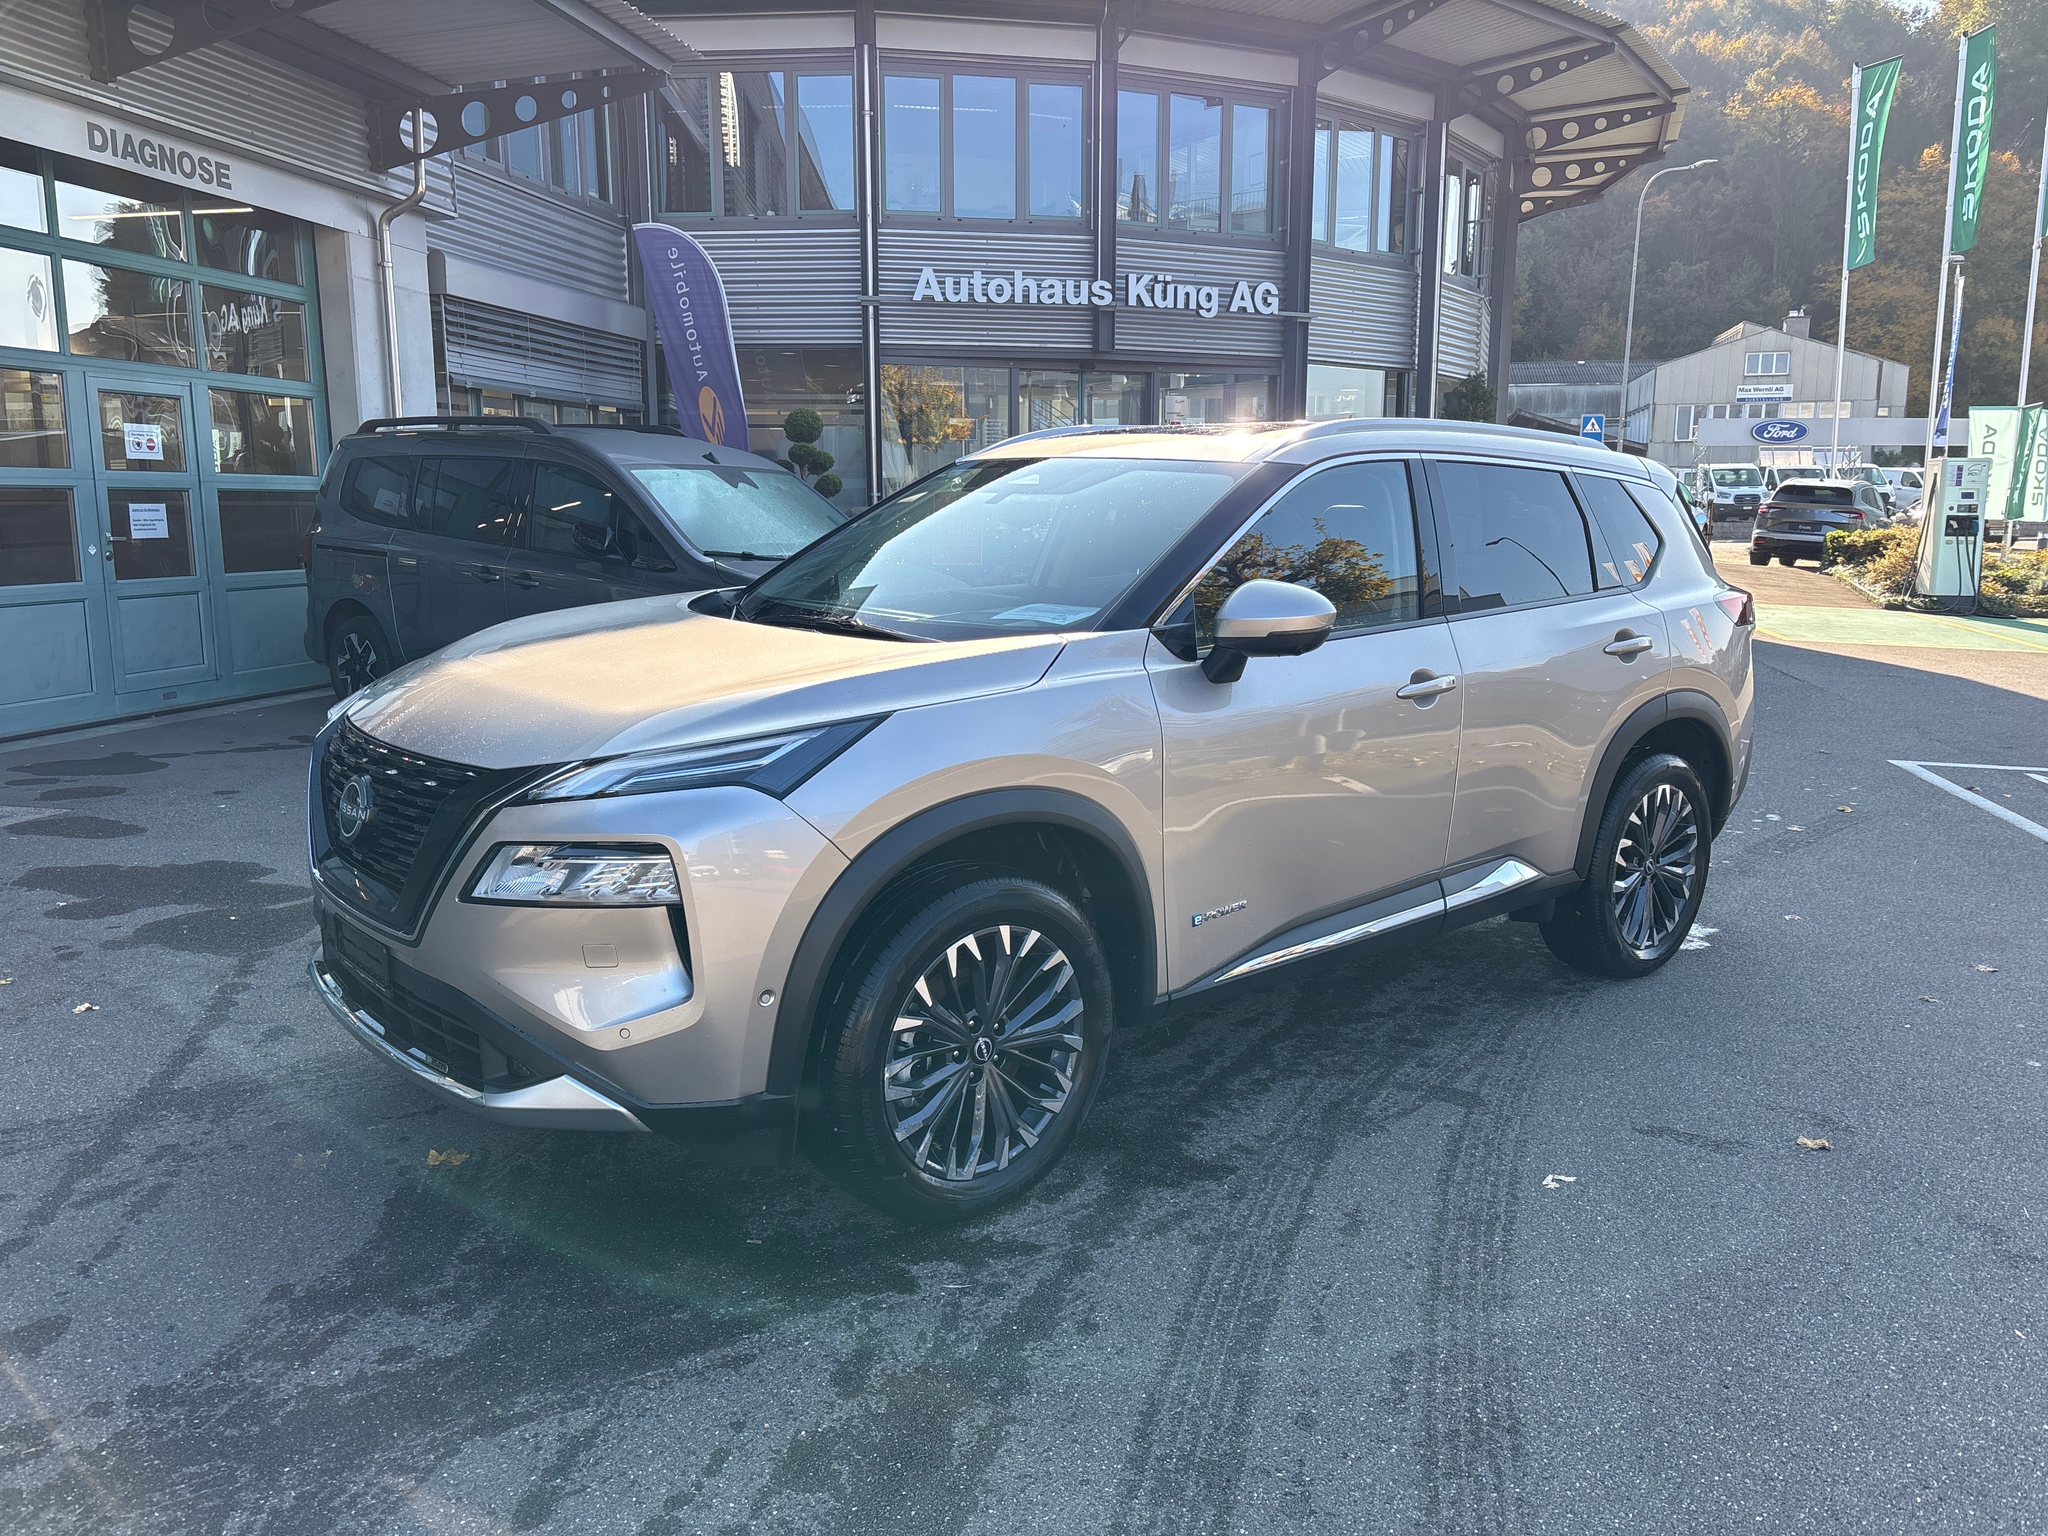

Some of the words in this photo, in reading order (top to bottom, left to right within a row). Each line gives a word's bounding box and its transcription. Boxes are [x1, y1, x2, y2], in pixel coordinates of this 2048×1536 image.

[86, 121, 232, 190] DIAGNOSE
[912, 267, 1113, 306] Autohaus
[1125, 273, 1219, 318] Küng
[1228, 280, 1279, 315] AG
[1763, 423, 1799, 438] Ford
